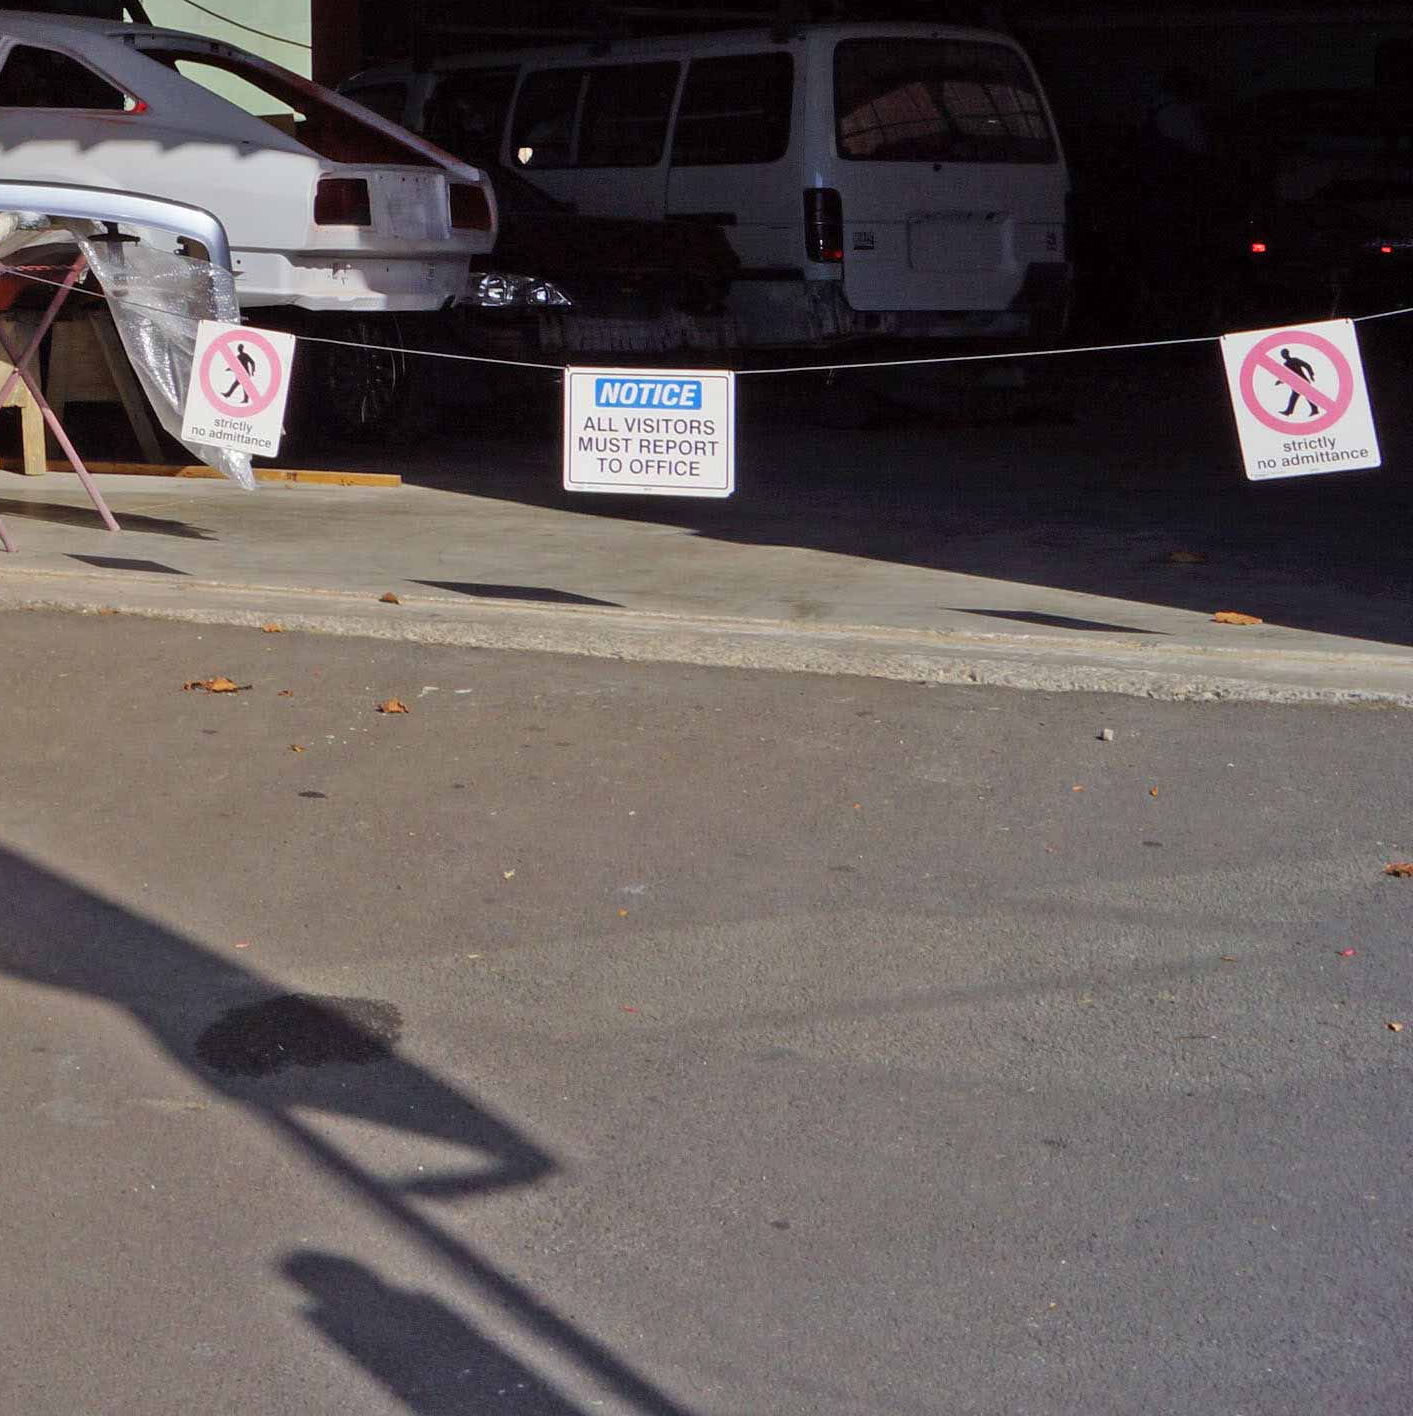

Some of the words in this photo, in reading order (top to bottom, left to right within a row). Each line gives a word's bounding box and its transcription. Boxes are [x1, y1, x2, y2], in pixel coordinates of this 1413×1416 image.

[599, 382, 698, 407] NOTICE
[213, 418, 253, 434] strictly
[583, 416, 619, 433] ALL
[624, 418, 716, 436] VISITORS
[191, 426, 205, 436] no
[209, 429, 271, 448] admittance
[578, 437, 632, 453] MUST
[639, 439, 719, 457] REPORT
[1283, 435, 1337, 453] strictly
[597, 458, 623, 474] TO
[629, 459, 701, 477] OFFICE
[1258, 458, 1277, 469] no
[1282, 448, 1368, 467] admittance
